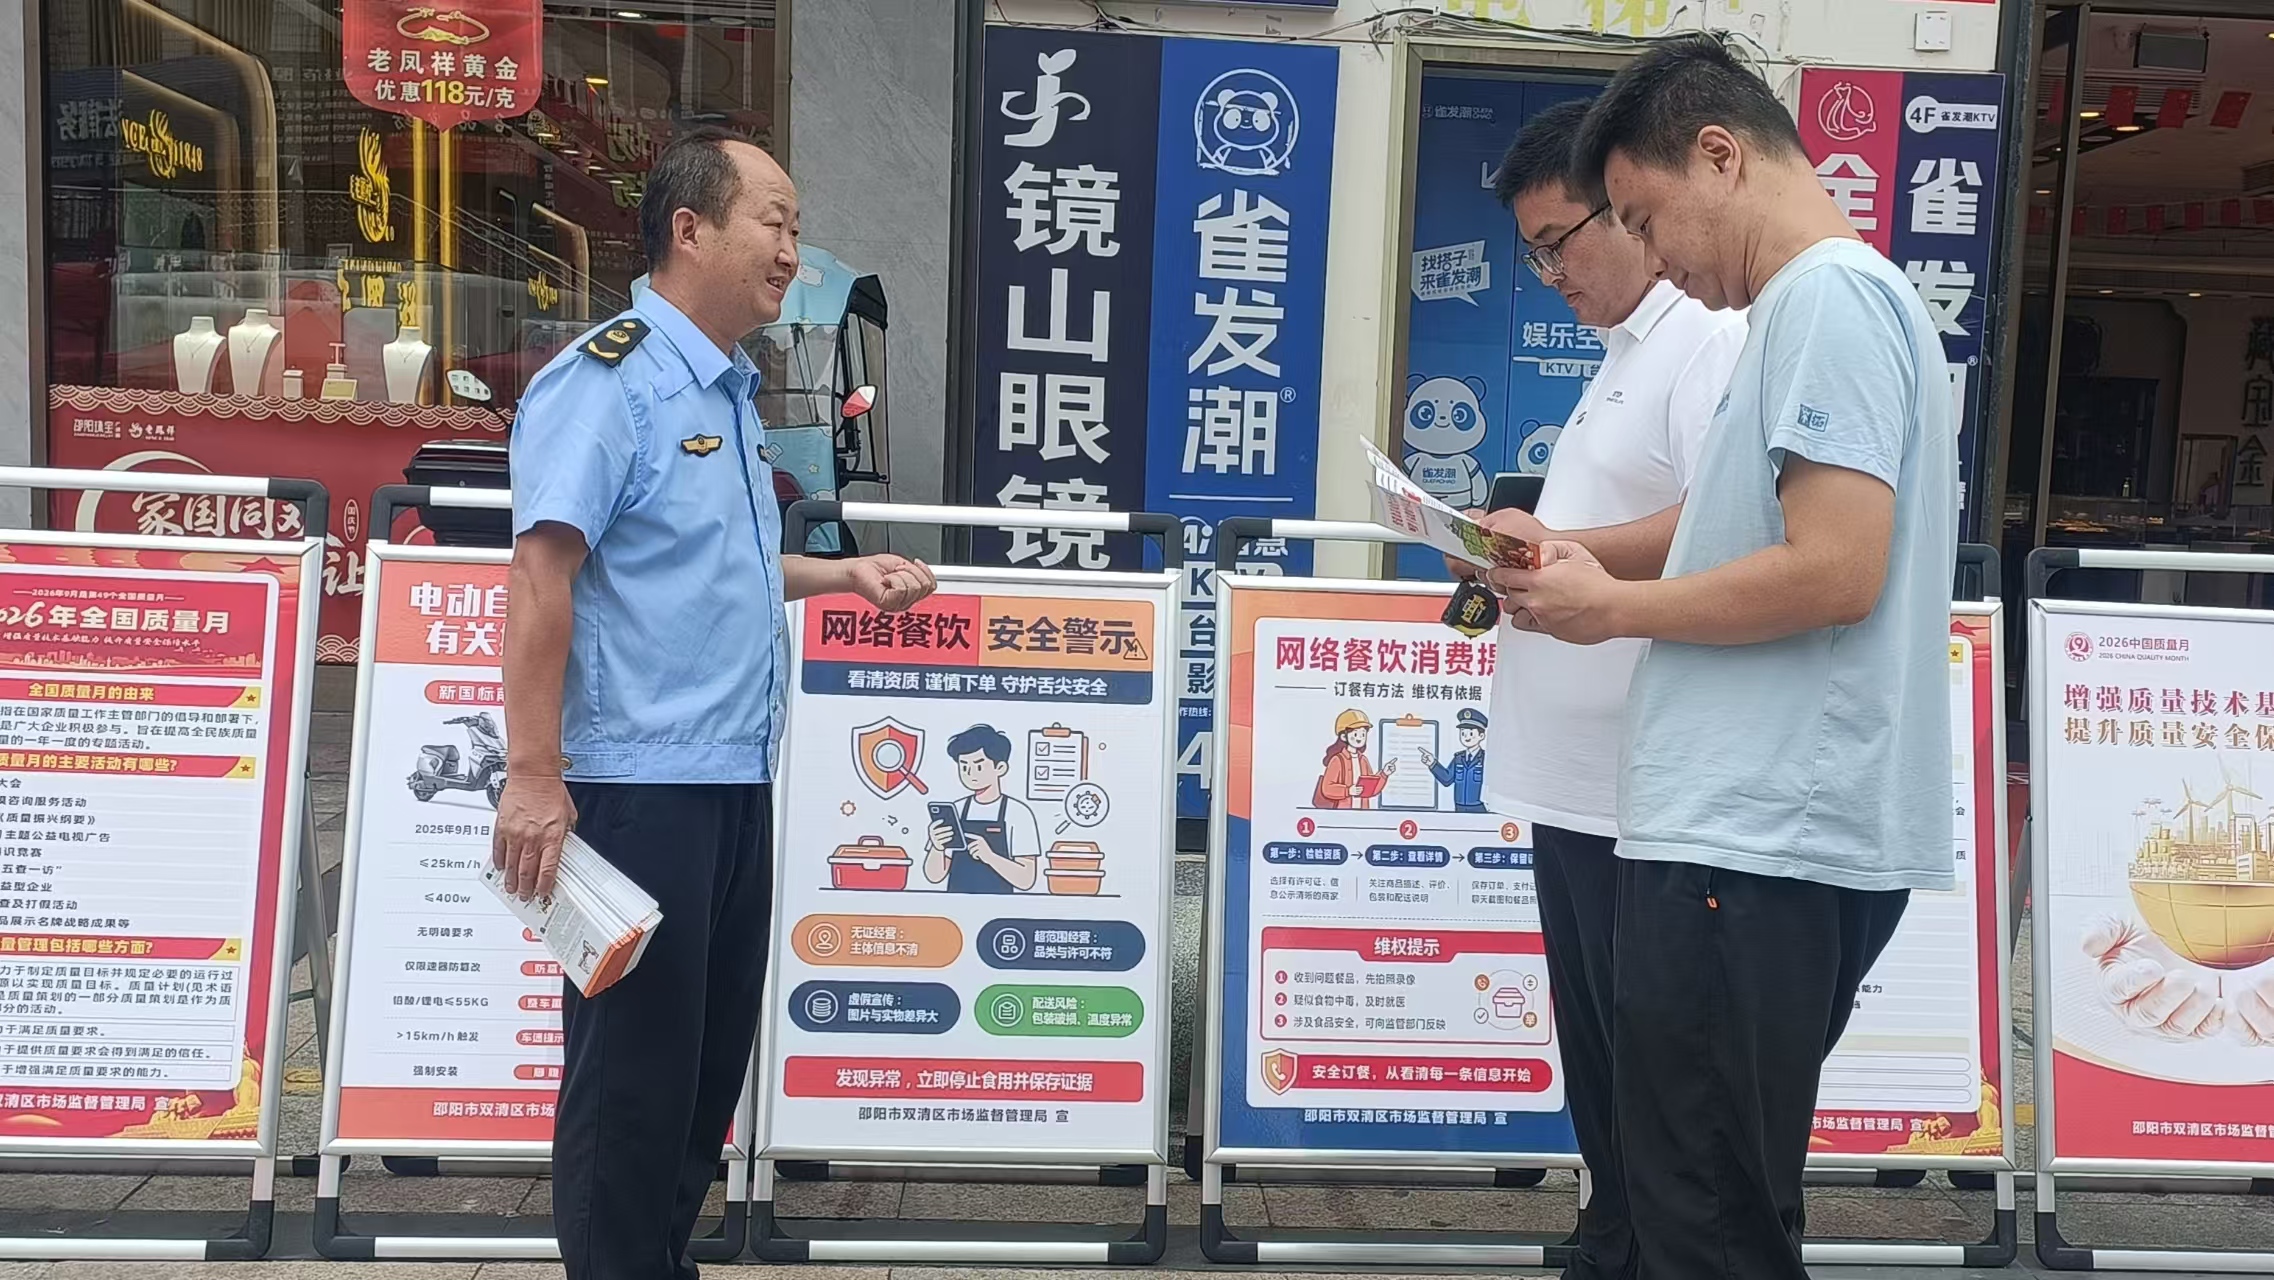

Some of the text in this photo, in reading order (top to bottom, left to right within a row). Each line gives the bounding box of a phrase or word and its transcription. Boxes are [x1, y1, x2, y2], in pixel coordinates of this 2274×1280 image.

[367, 47, 519, 81] 老凤祥黄金
[374, 79, 515, 109] 优惠118元/克
[1910, 107, 1996, 124] 4F 雀发潮KTV
[1421, 250, 1468, 272] 找搭子
[1420, 265, 1482, 291] 来雀发潮
[1522, 321, 1608, 351] 娱乐空
[996, 161, 1121, 569] 镜山眼镜
[1545, 362, 1575, 374] KTV
[347, 505, 356, 535] 国庆节
[425, 620, 507, 657] 有关
[821, 608, 1137, 655] 网络餐饮 安全警示
[2098, 636, 2190, 652] 2026中国质量月
[848, 669, 1108, 697] 看清资质 谨慎下单 守护舌尖安全
[1333, 681, 1482, 702] 订餐有方法 维权有依据
[28, 682, 155, 702] 全国质量月的由来
[415, 824, 490, 836] 2025年9月1日
[0, 881, 53, 893] 益型企业
[1269, 889, 1339, 901] 息公示清晰的商家
[1369, 892, 1429, 903] 包装和配送说明
[417, 926, 474, 938] 无明确要求
[850, 942, 918, 956] 主体信息不清
[1034, 945, 1113, 960] 品类与许可不符
[1374, 936, 1441, 957] 维权提示
[405, 961, 481, 972] 仅限速器防篡改
[1294, 971, 1416, 986] 收到问题餐品，先拍照录像
[1294, 994, 1406, 1008] 疑似食物中毒，及时就医
[847, 1008, 939, 1023] 图片与实物差异大
[1032, 1011, 1133, 1026] 包装破损、温度异常
[1293, 1016, 1447, 1031] 涉及食品安全，可向监管部门反映
[457, 1031, 479, 1042] 触发
[413, 1065, 459, 1077] 强制安装
[1312, 1063, 1533, 1083] 安全订餐，从看清每一条信息开始
[836, 1068, 1093, 1092] 发现异常，立即停止食用并保存证据
[0, 1093, 146, 1111] 清区市场监督管理局
[433, 1101, 555, 1118] 邵阳市双清区市场
[858, 1107, 1070, 1123] 邵阳市双清区市场监督管理局 宣
[1304, 1108, 1508, 1125] 邵阳市双清区市场监督管理局 宣
